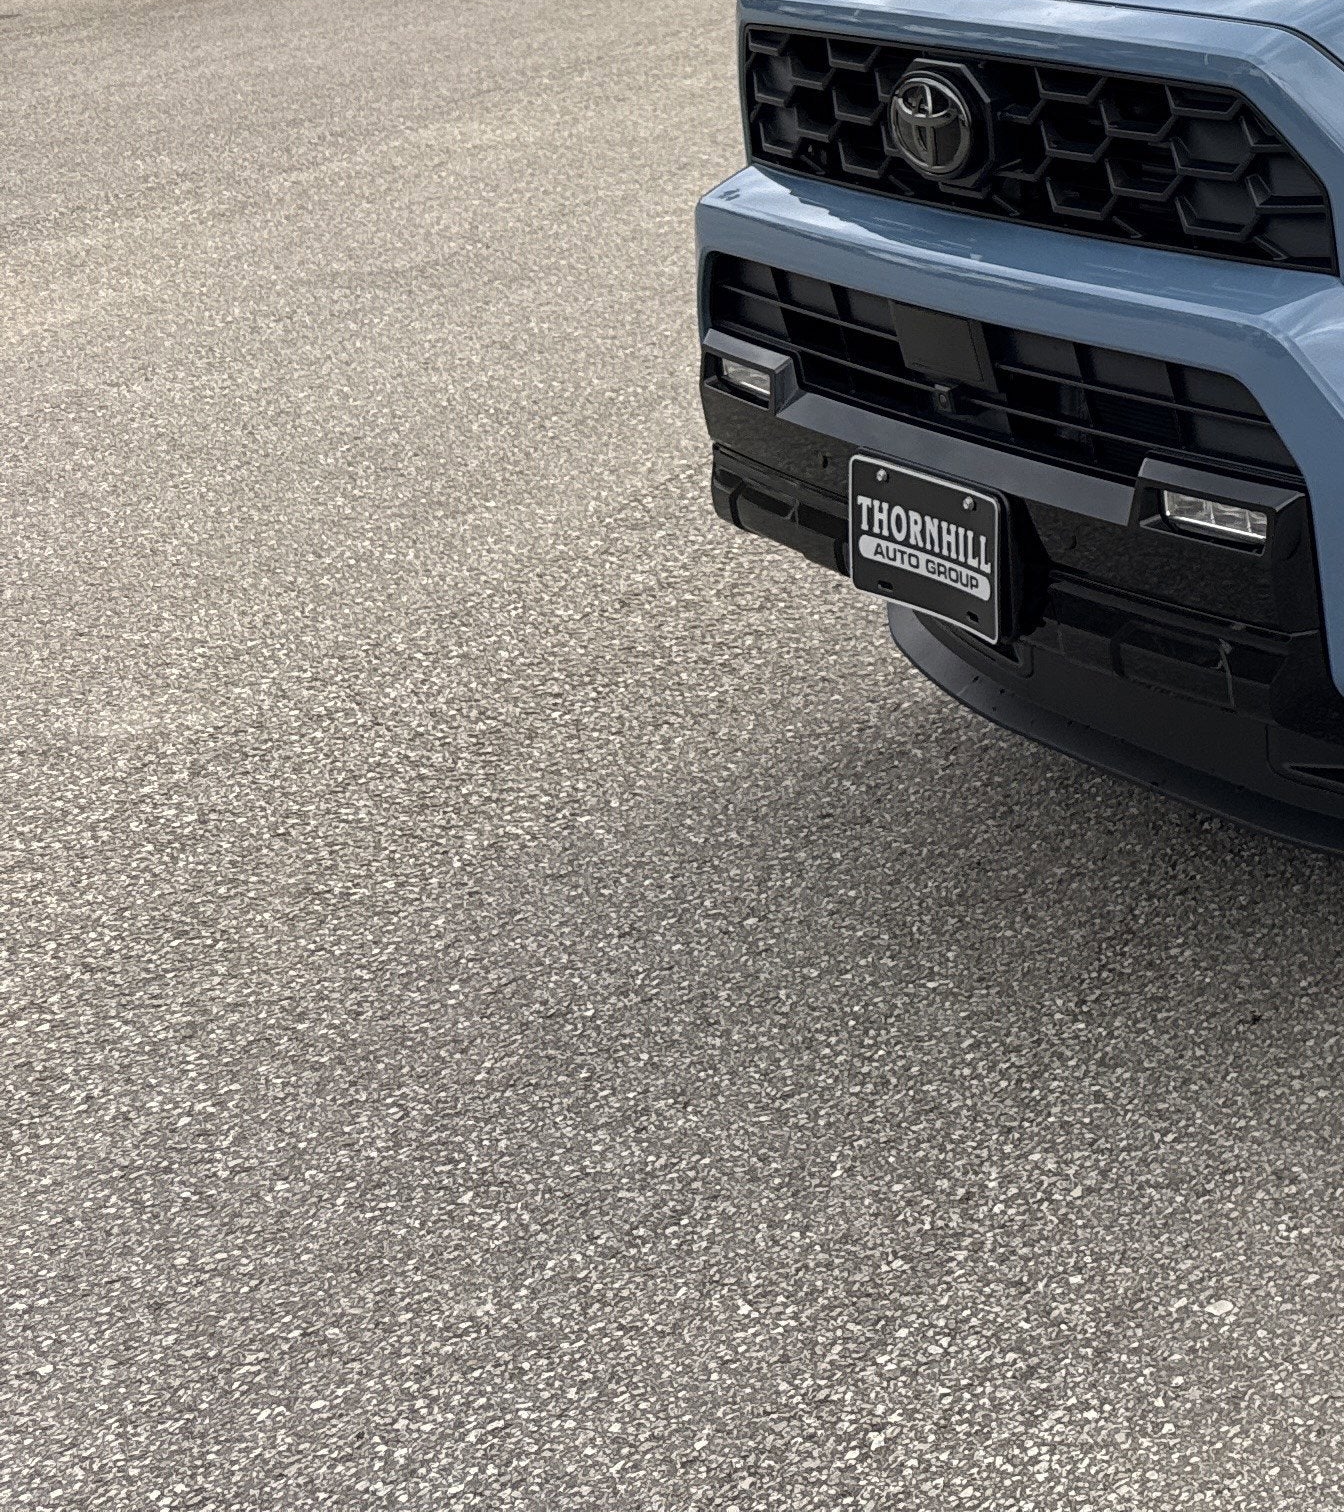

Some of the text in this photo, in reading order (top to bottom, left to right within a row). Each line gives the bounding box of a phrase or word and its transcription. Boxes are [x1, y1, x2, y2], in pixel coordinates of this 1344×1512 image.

[857, 495, 992, 574] THORNHILL
[873, 542, 979, 591] AUTO GROUP
